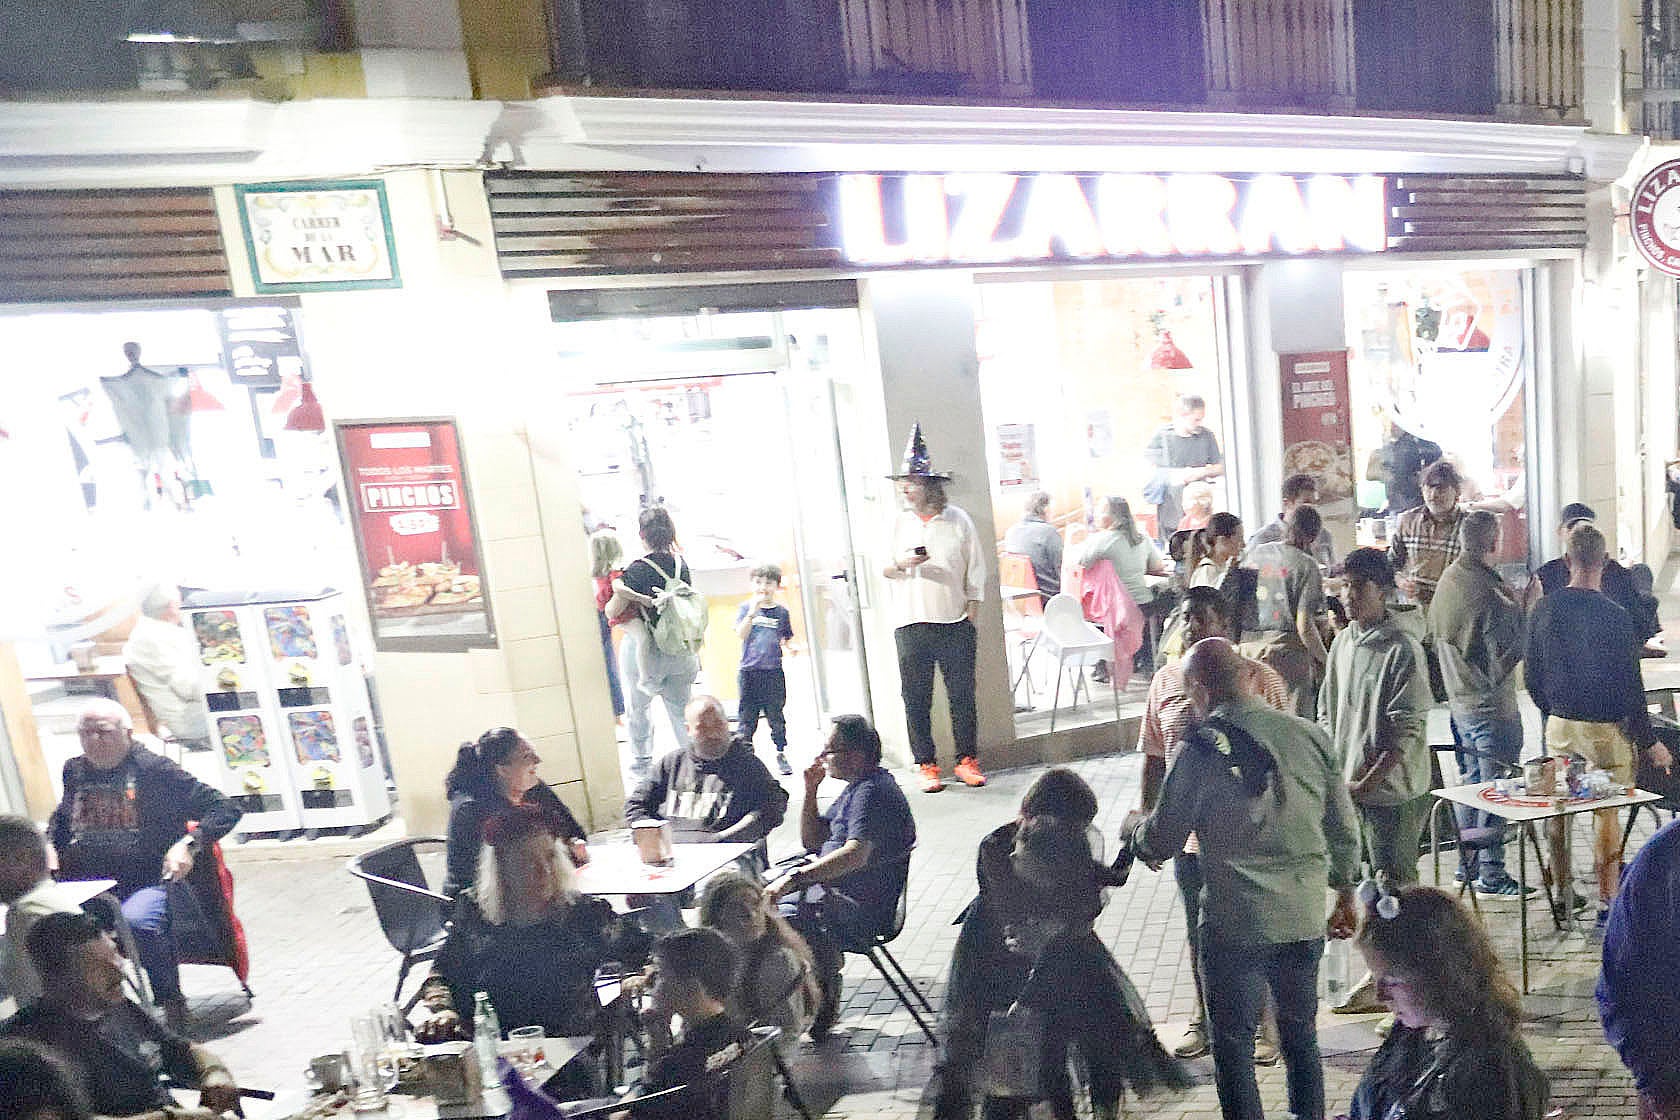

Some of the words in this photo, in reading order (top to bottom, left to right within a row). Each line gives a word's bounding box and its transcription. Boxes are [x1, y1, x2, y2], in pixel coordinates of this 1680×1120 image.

[838, 172, 1387, 264] LIZARRAN
[290, 244, 357, 264] MAR
[367, 485, 454, 508] PINCHOS
